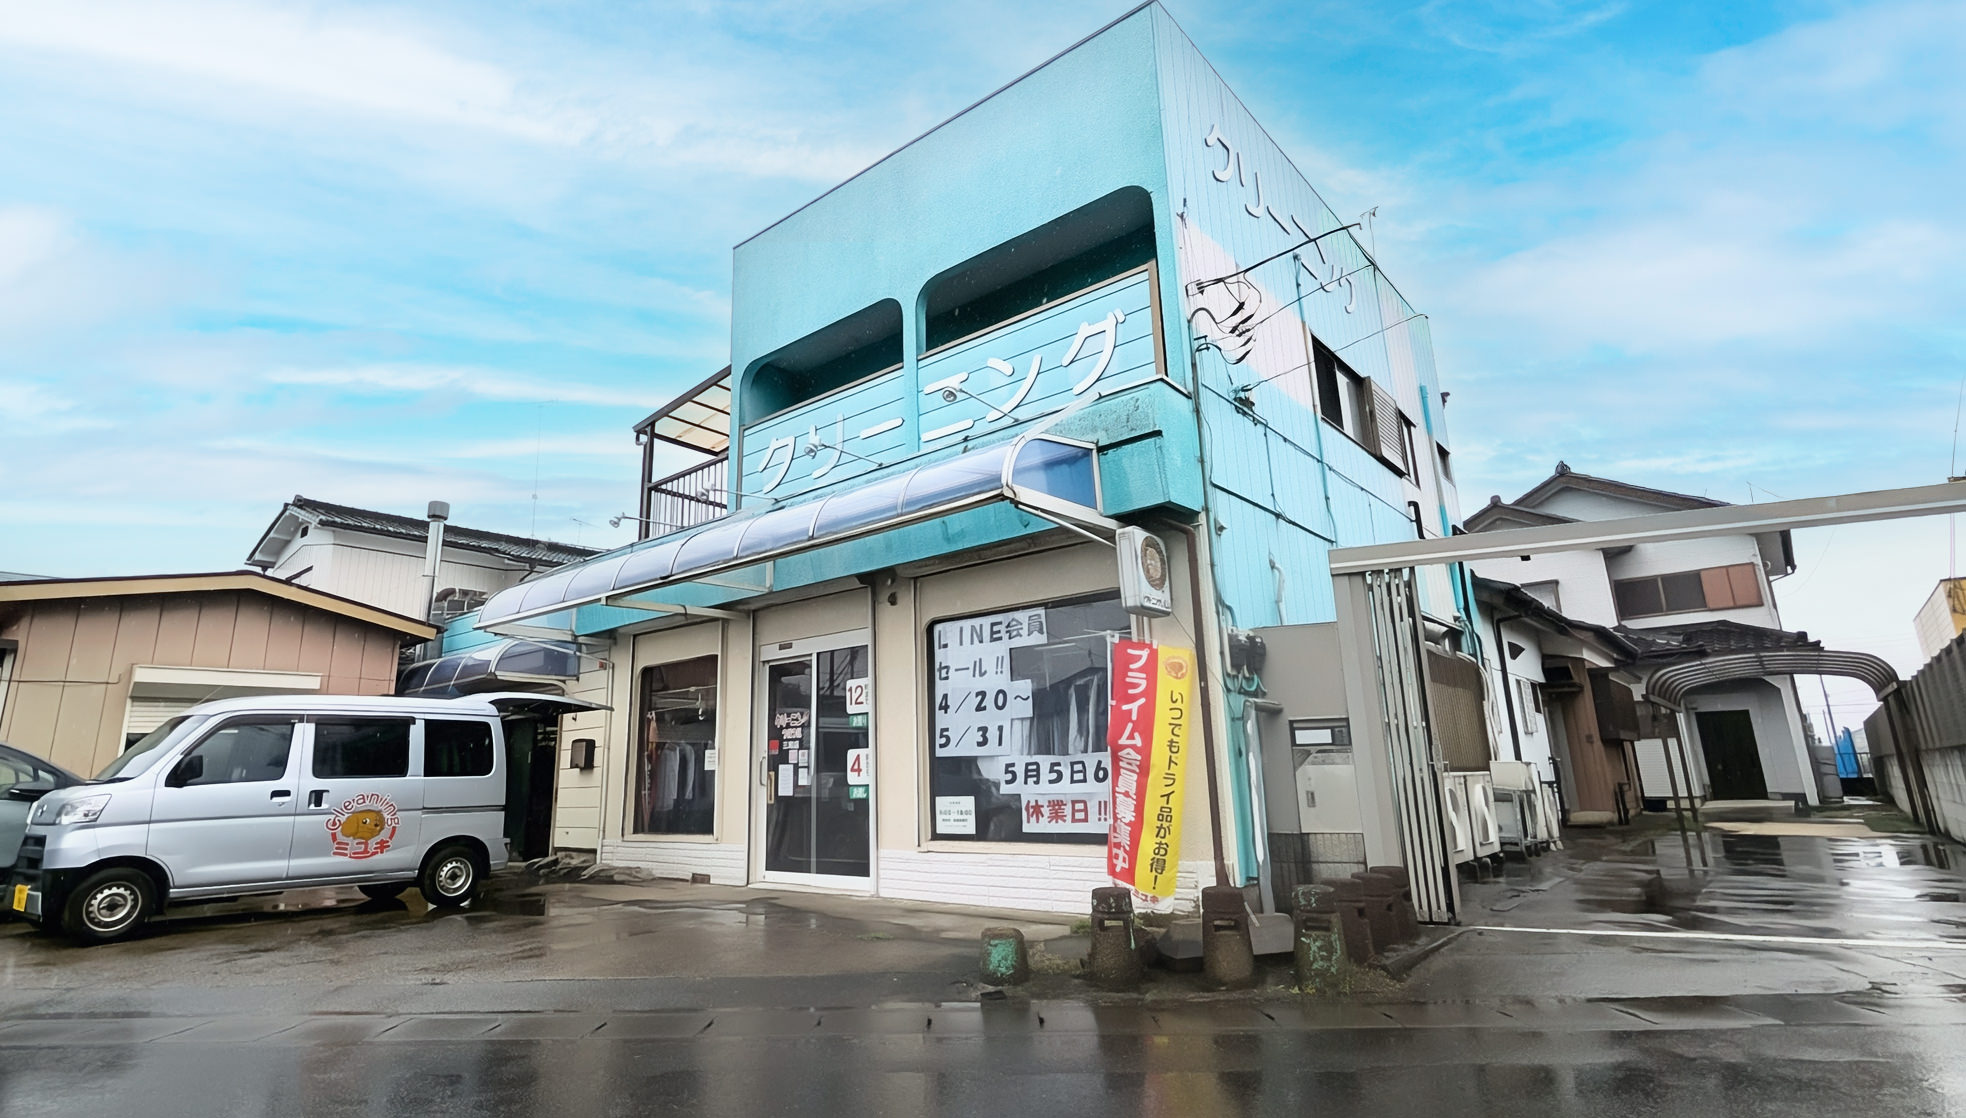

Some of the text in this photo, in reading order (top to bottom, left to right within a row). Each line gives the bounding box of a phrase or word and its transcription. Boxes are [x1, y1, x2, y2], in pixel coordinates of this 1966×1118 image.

[758, 308, 1126, 494] クリーニング
[938, 613, 1045, 649] LINE会員
[848, 684, 864, 706] 12
[938, 725, 1004, 748] 5/31
[850, 753, 862, 777] 4
[326, 793, 400, 831] Cleaning
[1024, 799, 1108, 824] 休業日!!
[332, 839, 391, 857] ミユキ
